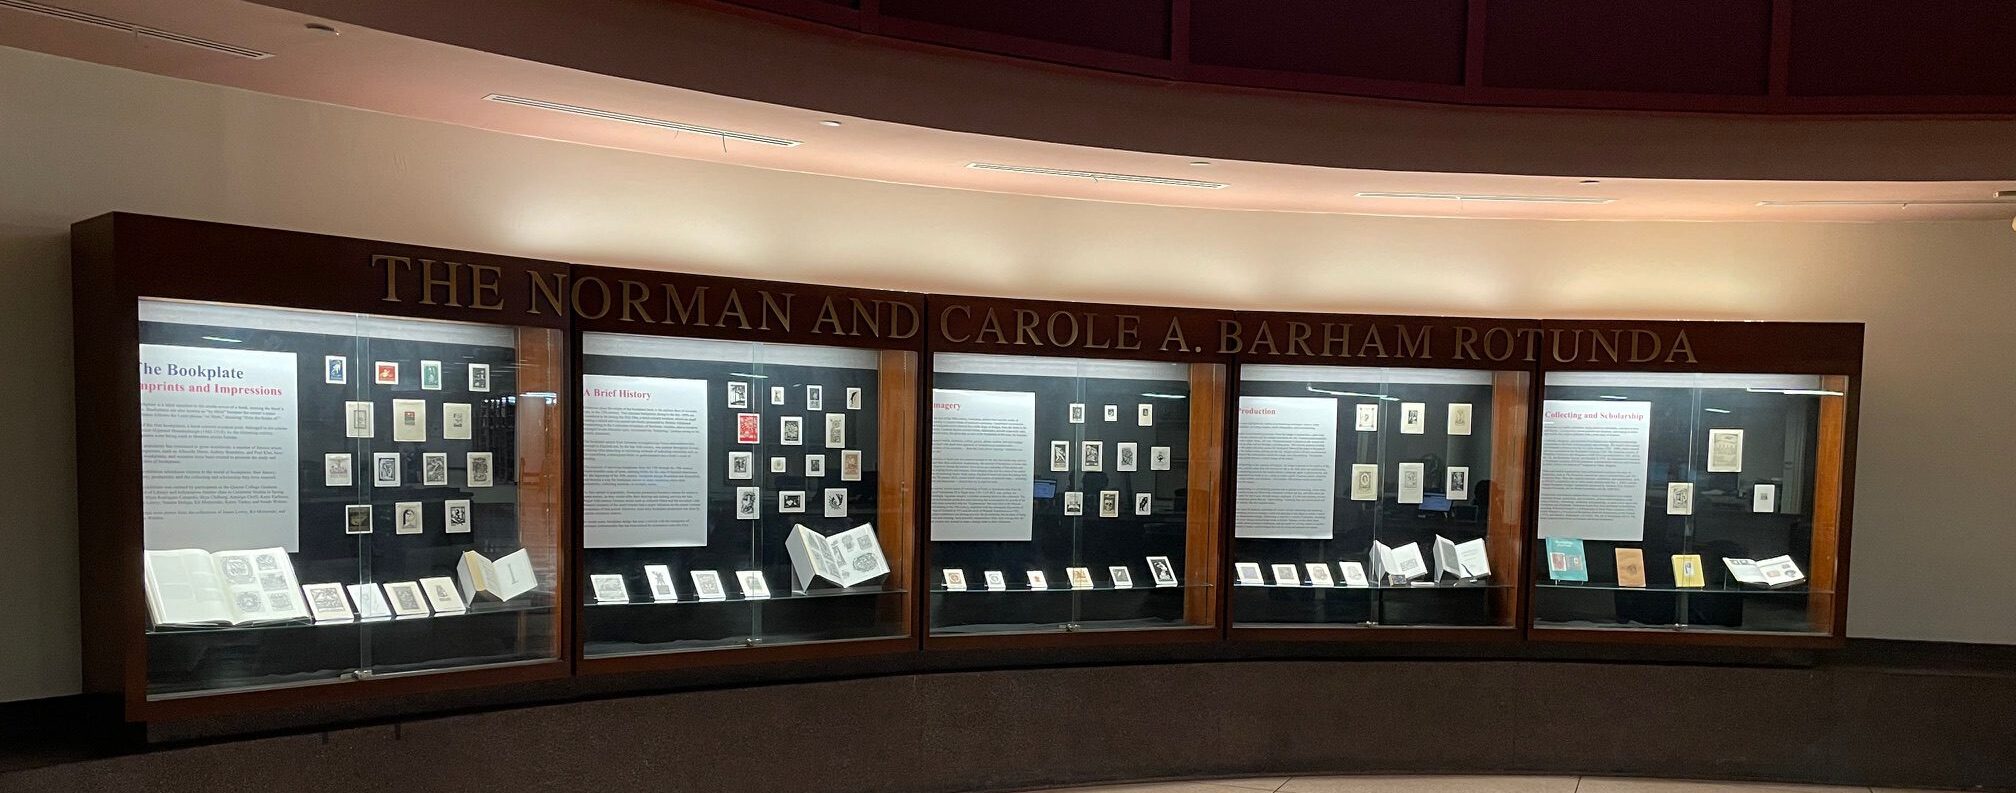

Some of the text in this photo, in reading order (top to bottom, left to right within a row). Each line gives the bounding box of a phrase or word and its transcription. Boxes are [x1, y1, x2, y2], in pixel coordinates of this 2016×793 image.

[371, 254, 1698, 364] THE NORMAN AND CAROLE A. BARHAM ROTUNDA
[139, 362, 244, 381] he Bookplate
[139, 381, 282, 396] mprints and Impressions
[584, 388, 651, 401] A Brief History
[1545, 411, 1644, 421] Collecting and Scholarship
